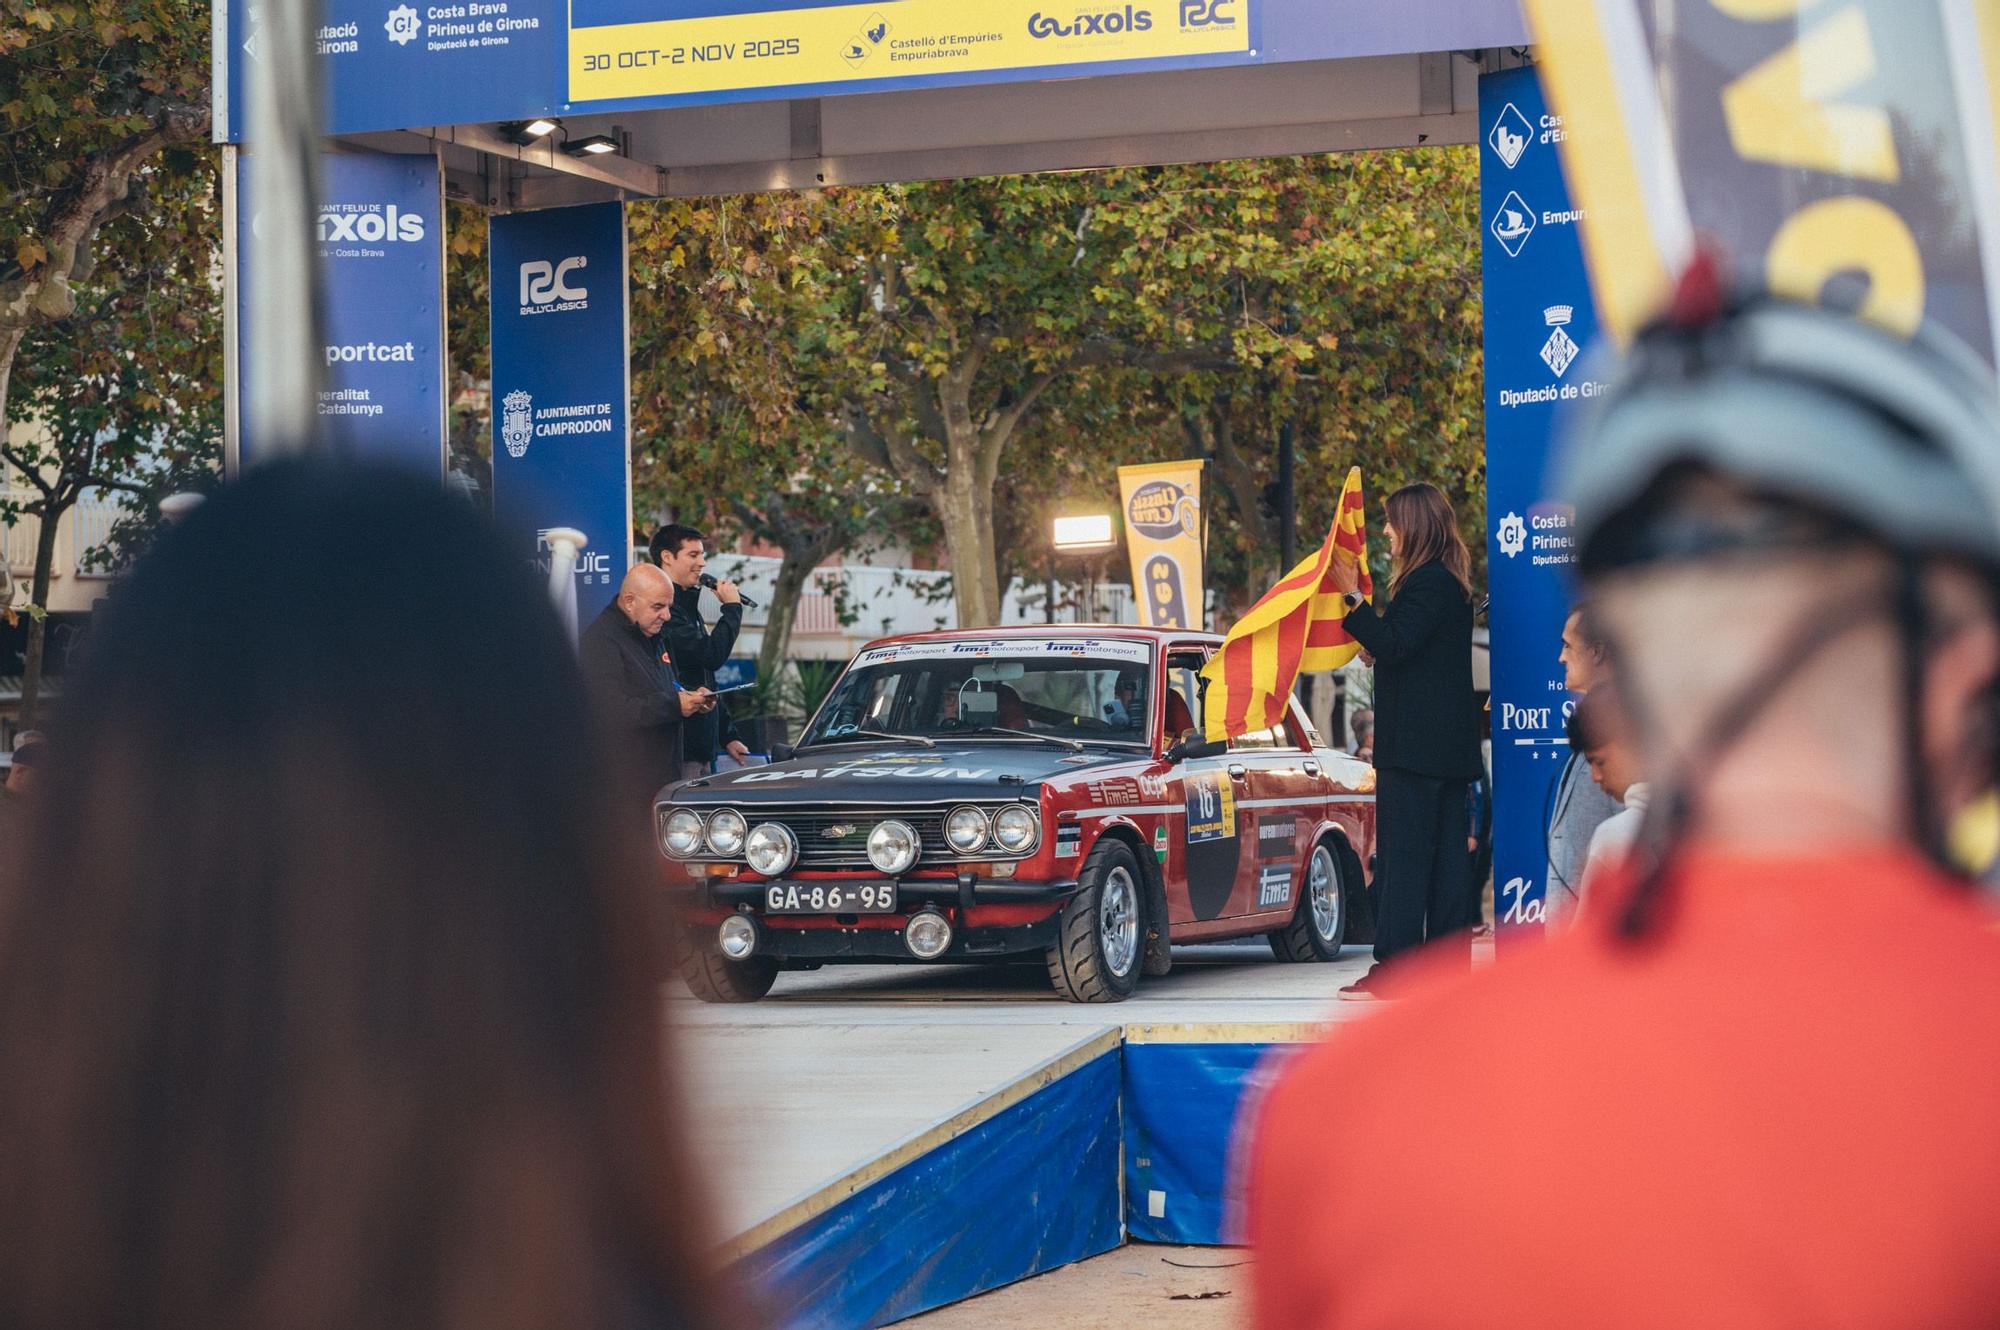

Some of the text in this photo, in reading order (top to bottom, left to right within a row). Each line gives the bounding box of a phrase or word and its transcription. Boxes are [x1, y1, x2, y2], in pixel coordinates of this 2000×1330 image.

[427, 2, 508, 20] Costa Brava
[393, 16, 412, 33] G!
[427, 17, 540, 37] Pirineu de Girona
[427, 36, 510, 52] Diputació de Girona
[890, 32, 1004, 49] Castelló d'Empúries
[583, 37, 801, 72] 30 OCT-2 NOV 2025
[889, 48, 970, 62] Empuriabrava
[342, 204, 367, 213] FELIU
[369, 204, 382, 213] DE
[316, 204, 425, 242] íxols
[335, 249, 360, 257] Costa
[361, 249, 385, 257] Brava
[520, 300, 588, 316] RALLYCLASSICS
[325, 342, 415, 367] portcat
[1500, 381, 1612, 408] Diputació de Giro
[316, 403, 384, 417] Catalunya
[536, 403, 611, 420] AJUNTAMENT DE
[535, 418, 612, 437] CAMPRODON
[1531, 514, 1567, 530] Costa
[1503, 525, 1519, 545] G!
[1532, 534, 1576, 550] Pirineu
[1532, 553, 1569, 567] Diputació
[1548, 680, 1568, 691] Ho
[1500, 700, 1577, 730] PORT S
[731, 763, 989, 785] DATSUN
[1194, 780, 1214, 819] 16
[768, 886, 893, 910] GA-86-95
